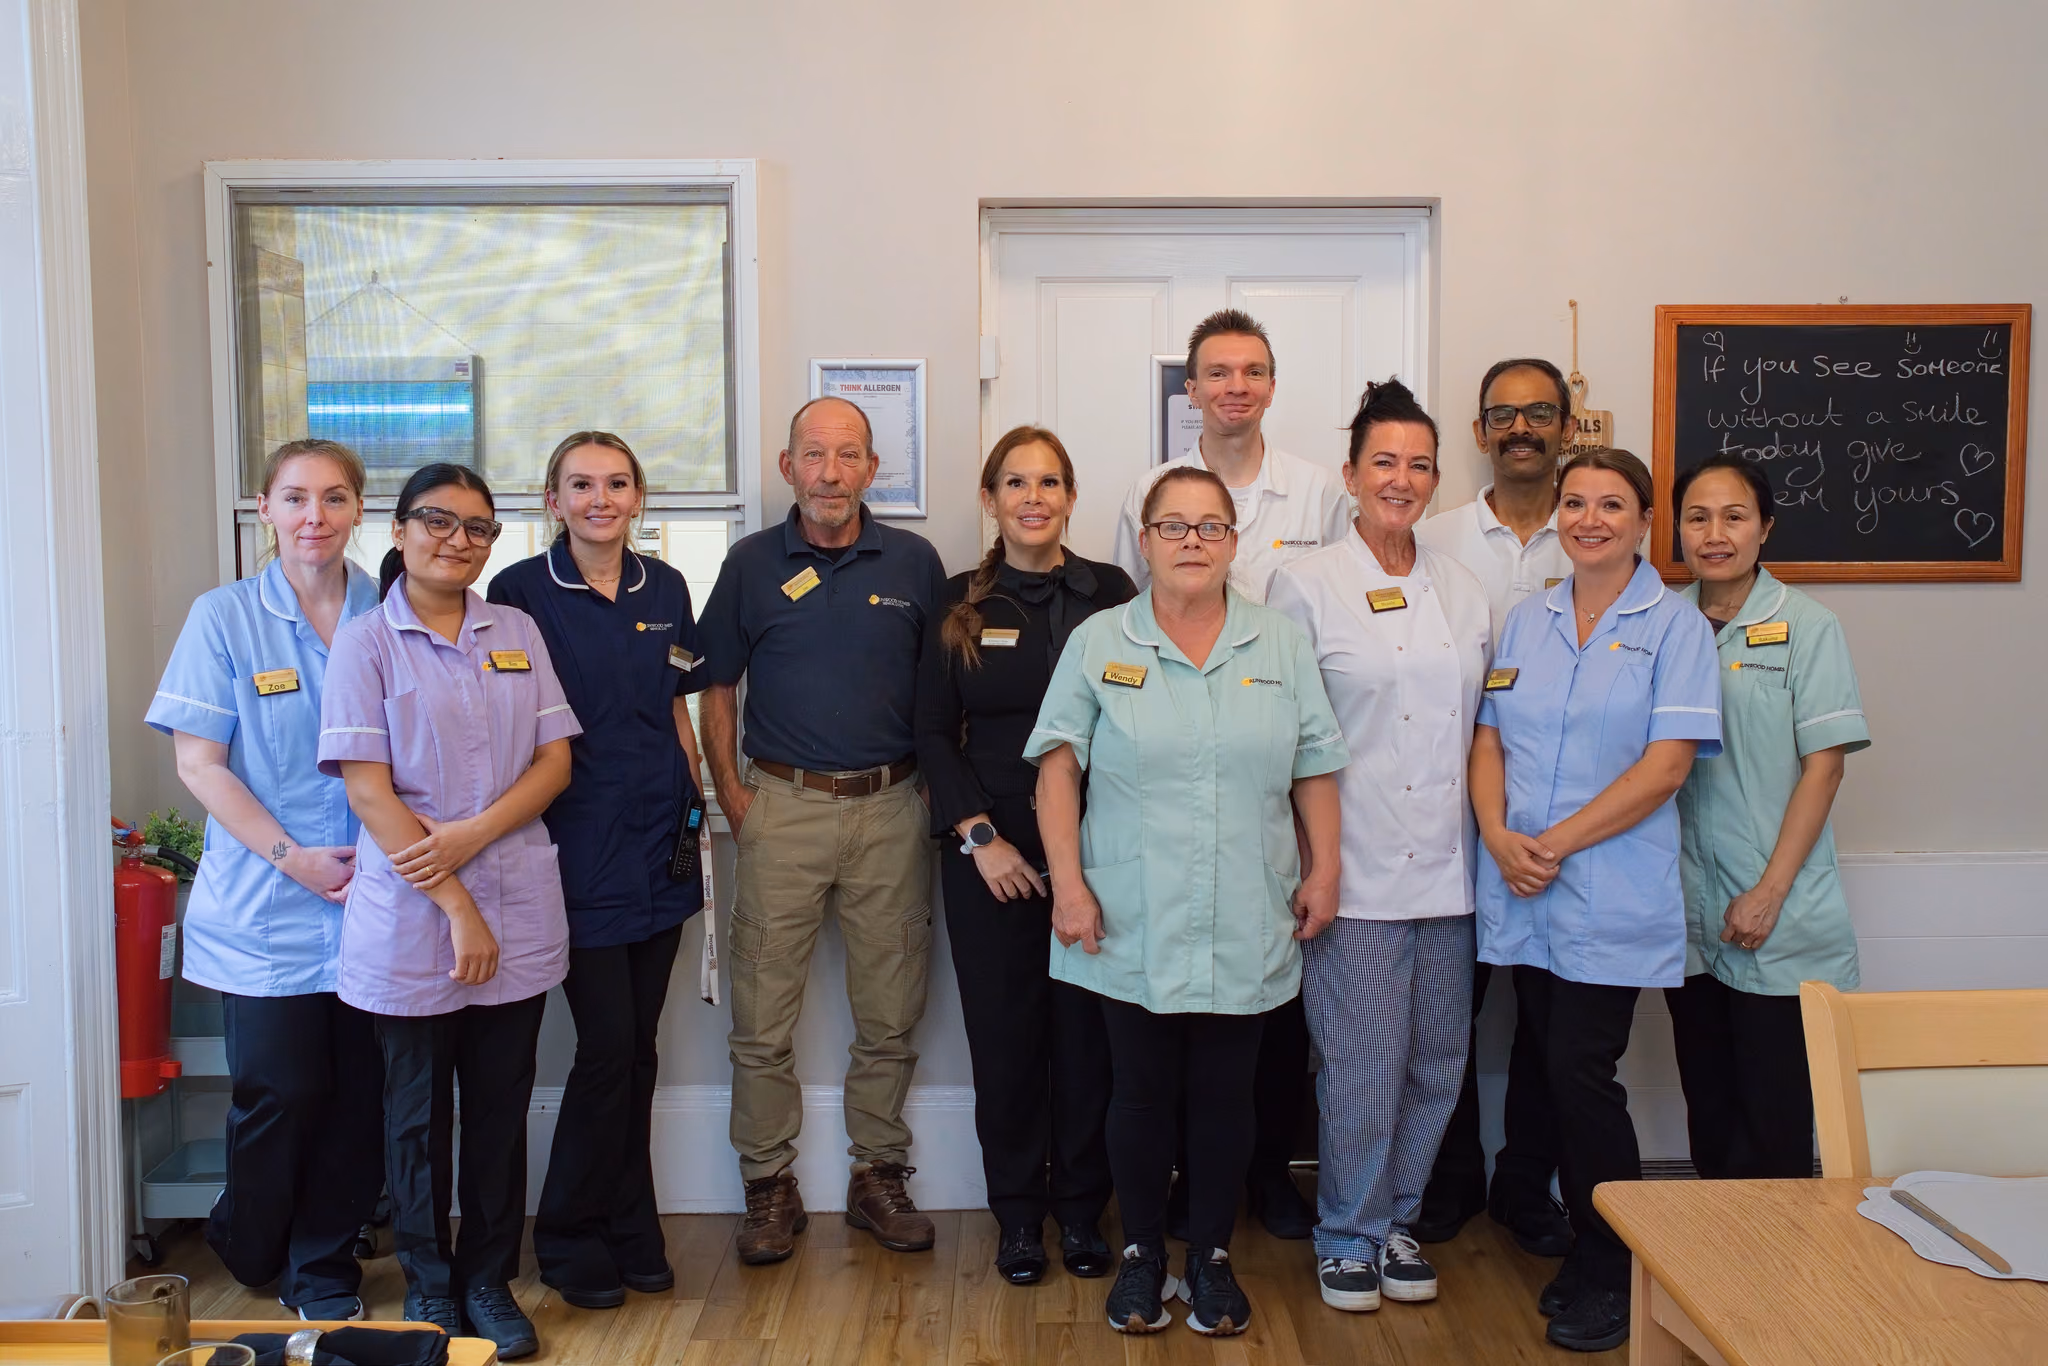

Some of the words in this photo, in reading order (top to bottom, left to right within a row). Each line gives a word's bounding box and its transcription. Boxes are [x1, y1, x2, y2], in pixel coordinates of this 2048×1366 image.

[840, 384, 862, 392] THINK
[863, 384, 901, 392] ALLERGEN
[1704, 354, 1726, 383] If
[1740, 356, 1800, 406] you
[1707, 397, 1844, 429] without
[1866, 409, 1890, 425] a
[1577, 418, 1602, 433] ALS
[1717, 432, 1826, 487] today
[1847, 438, 1923, 484] give
[1853, 480, 1960, 535] yours
[268, 683, 286, 692] Zoe
[1110, 671, 1138, 685] Wendy
